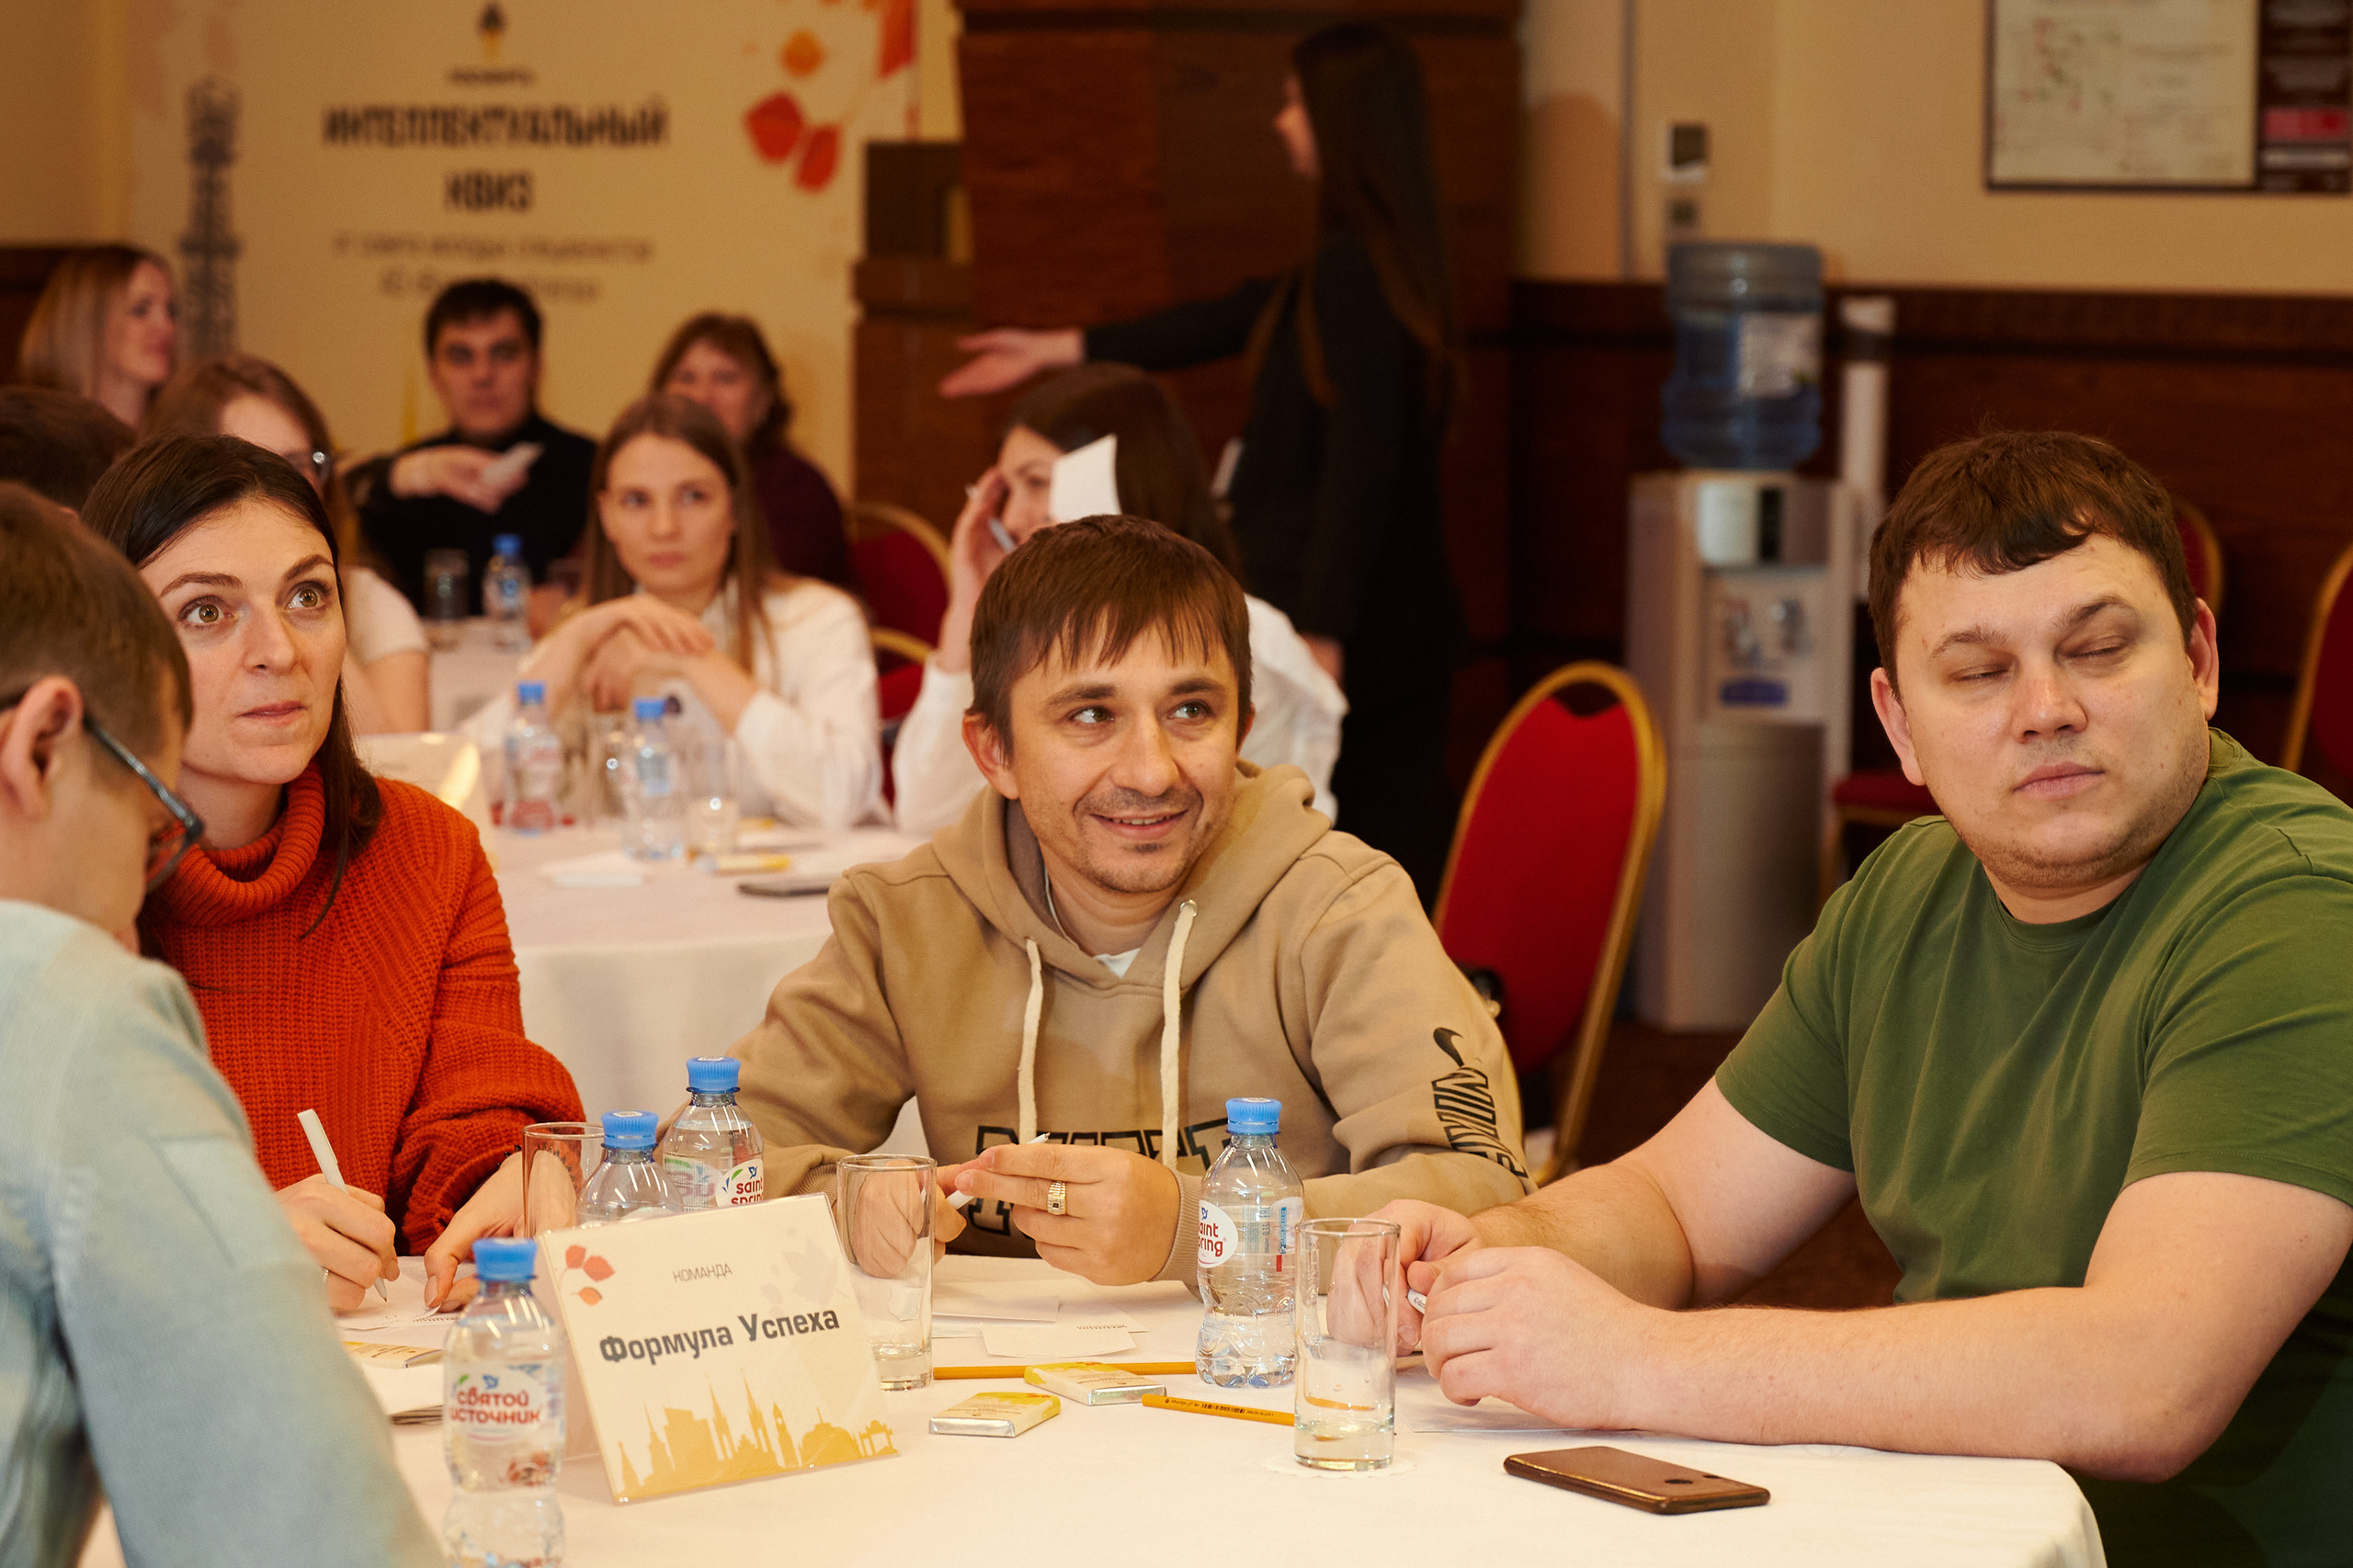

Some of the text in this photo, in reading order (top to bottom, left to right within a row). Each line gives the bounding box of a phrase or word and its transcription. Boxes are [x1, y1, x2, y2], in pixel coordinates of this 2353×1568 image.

[324, 94, 668, 145] ИНТЕЛЛЕКТУАЛЬНЫЙ
[599, 1309, 840, 1366] Формула Успеха
